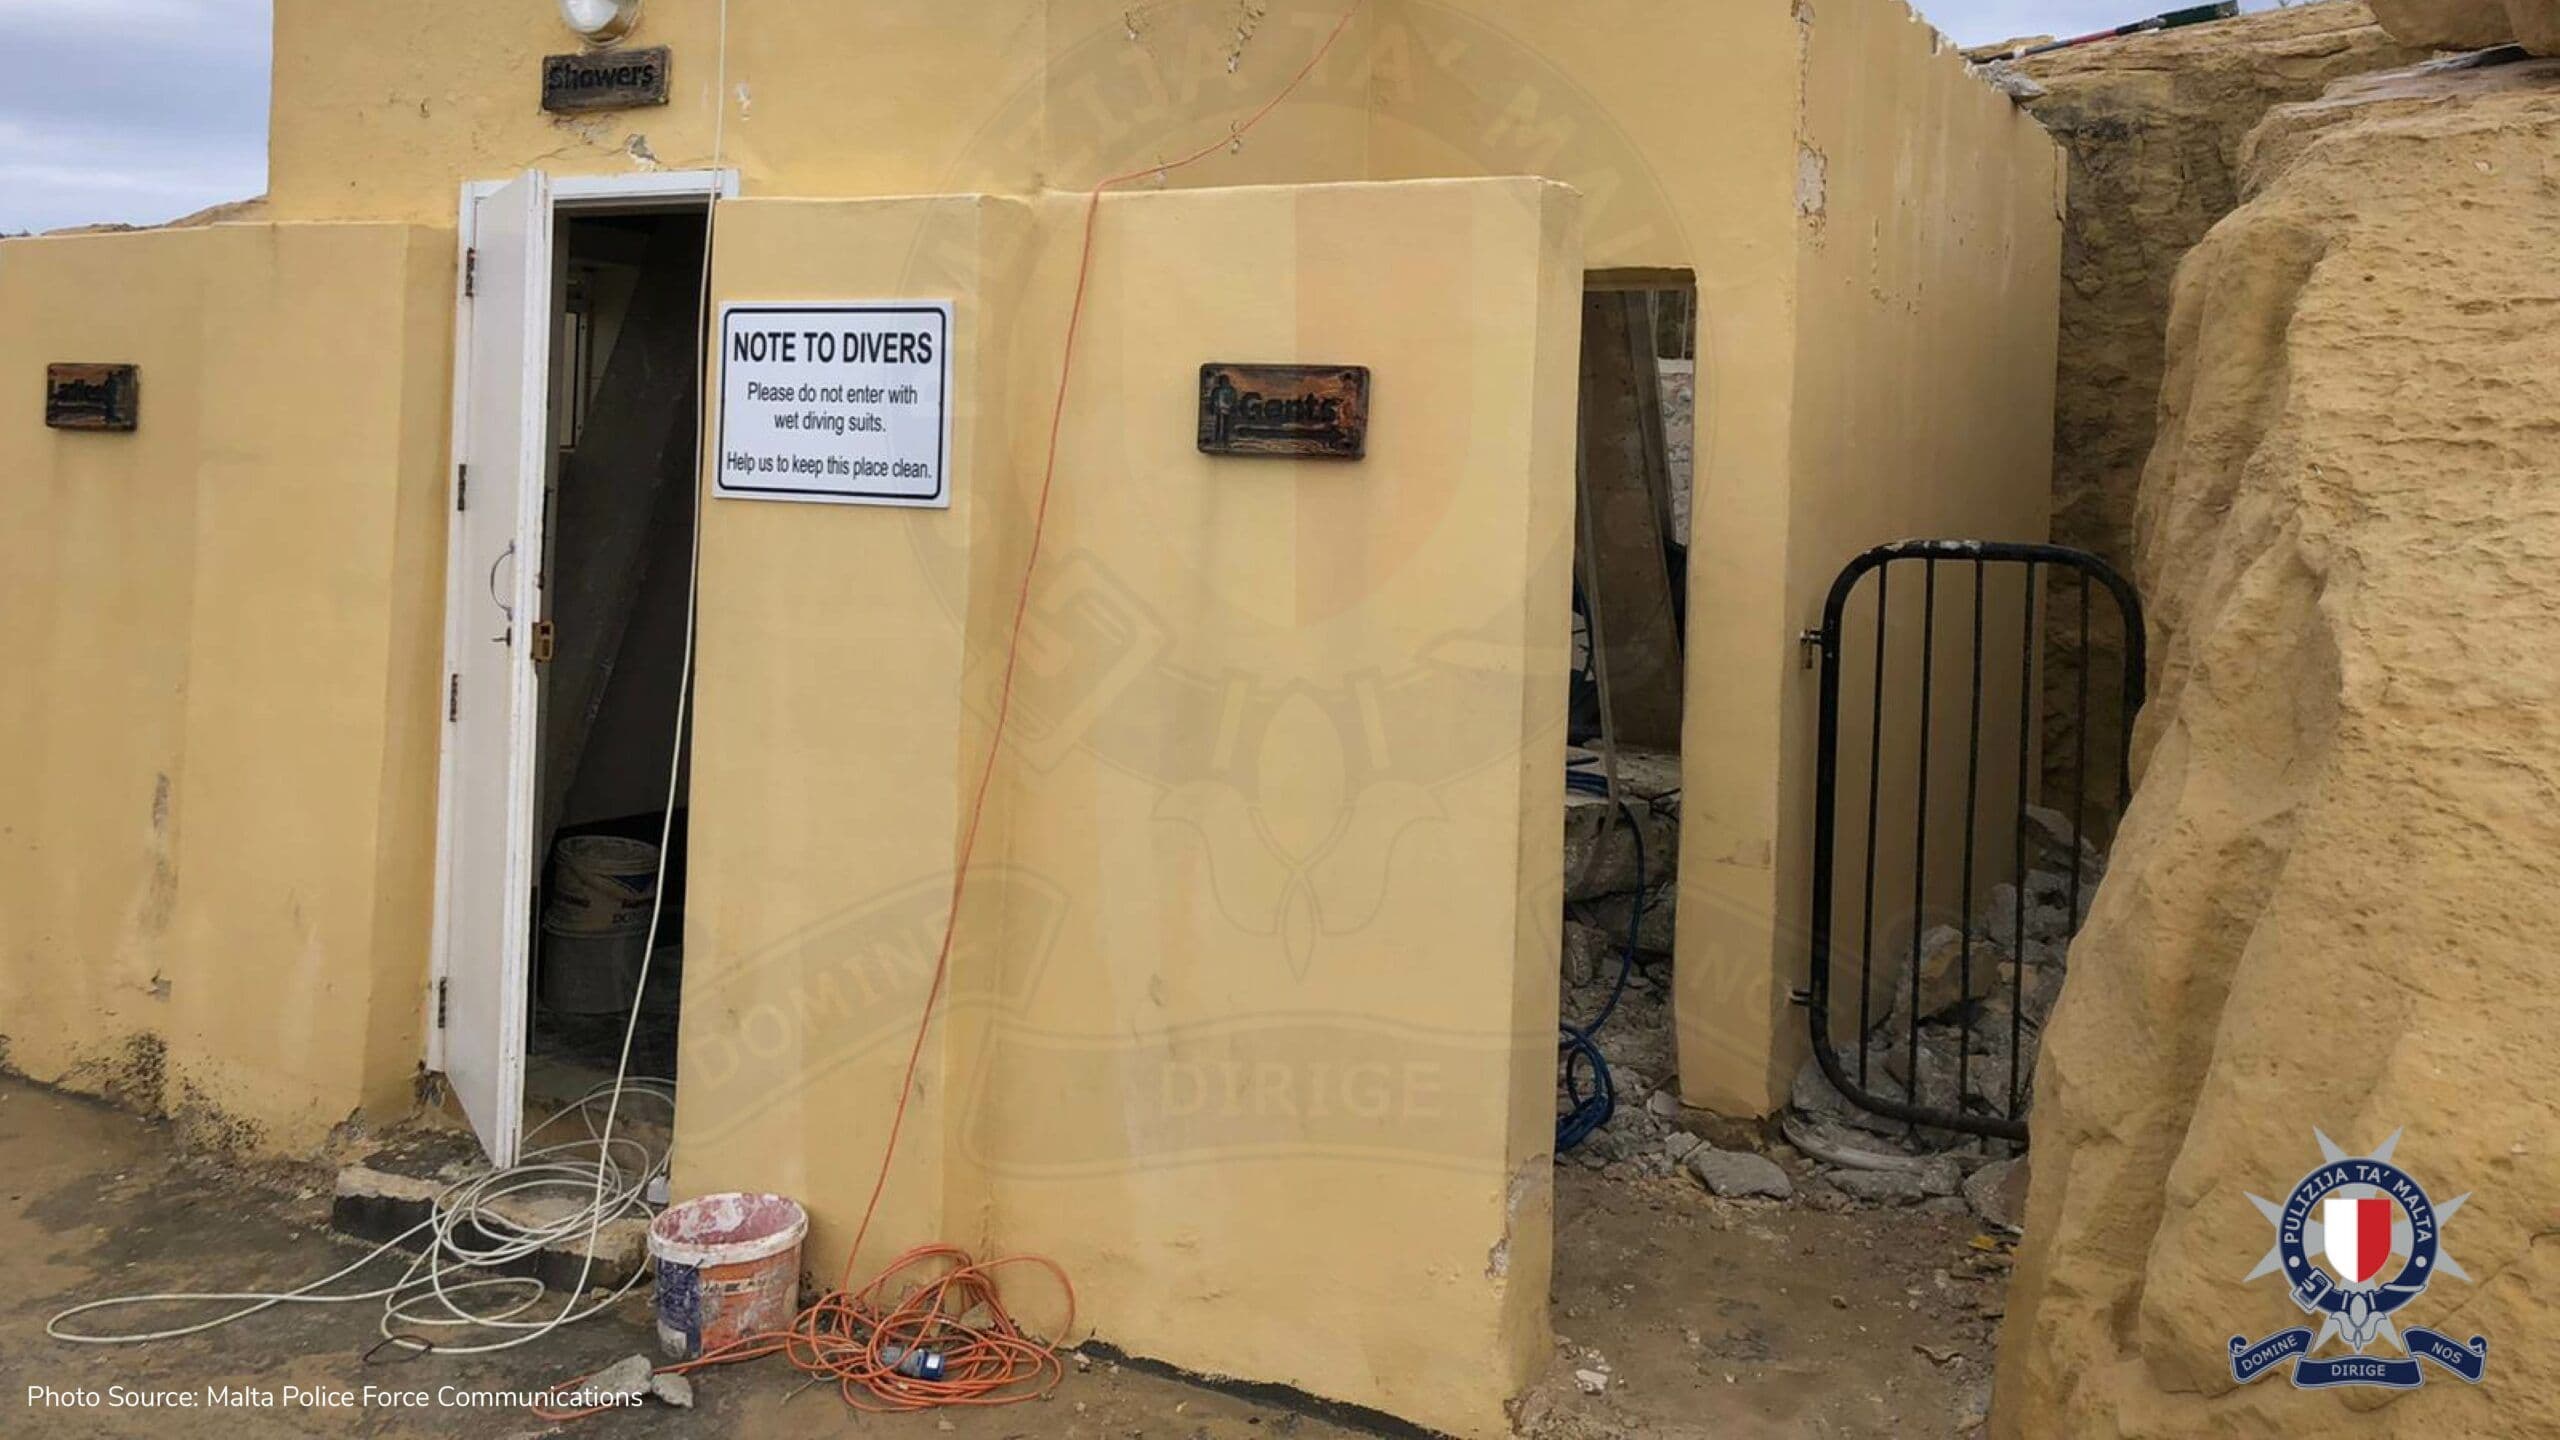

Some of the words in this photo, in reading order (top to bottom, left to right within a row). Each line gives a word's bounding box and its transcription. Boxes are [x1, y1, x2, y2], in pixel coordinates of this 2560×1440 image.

[733, 331, 796, 363] NOTE
[803, 331, 836, 363] TO
[842, 332, 933, 364] DIVERS
[747, 381, 795, 403] Please
[798, 383, 817, 403] do
[820, 384, 843, 404] not
[846, 385, 885, 405] enter
[887, 384, 918, 405] with
[774, 411, 800, 430] wet
[802, 410, 845, 436] diving
[848, 411, 887, 433] suits.
[726, 451, 756, 475] Help
[758, 456, 774, 473] us
[777, 454, 790, 474] to
[792, 455, 824, 479] keep
[827, 456, 850, 476] this
[853, 457, 889, 481] place
[892, 457, 933, 480] clean.
